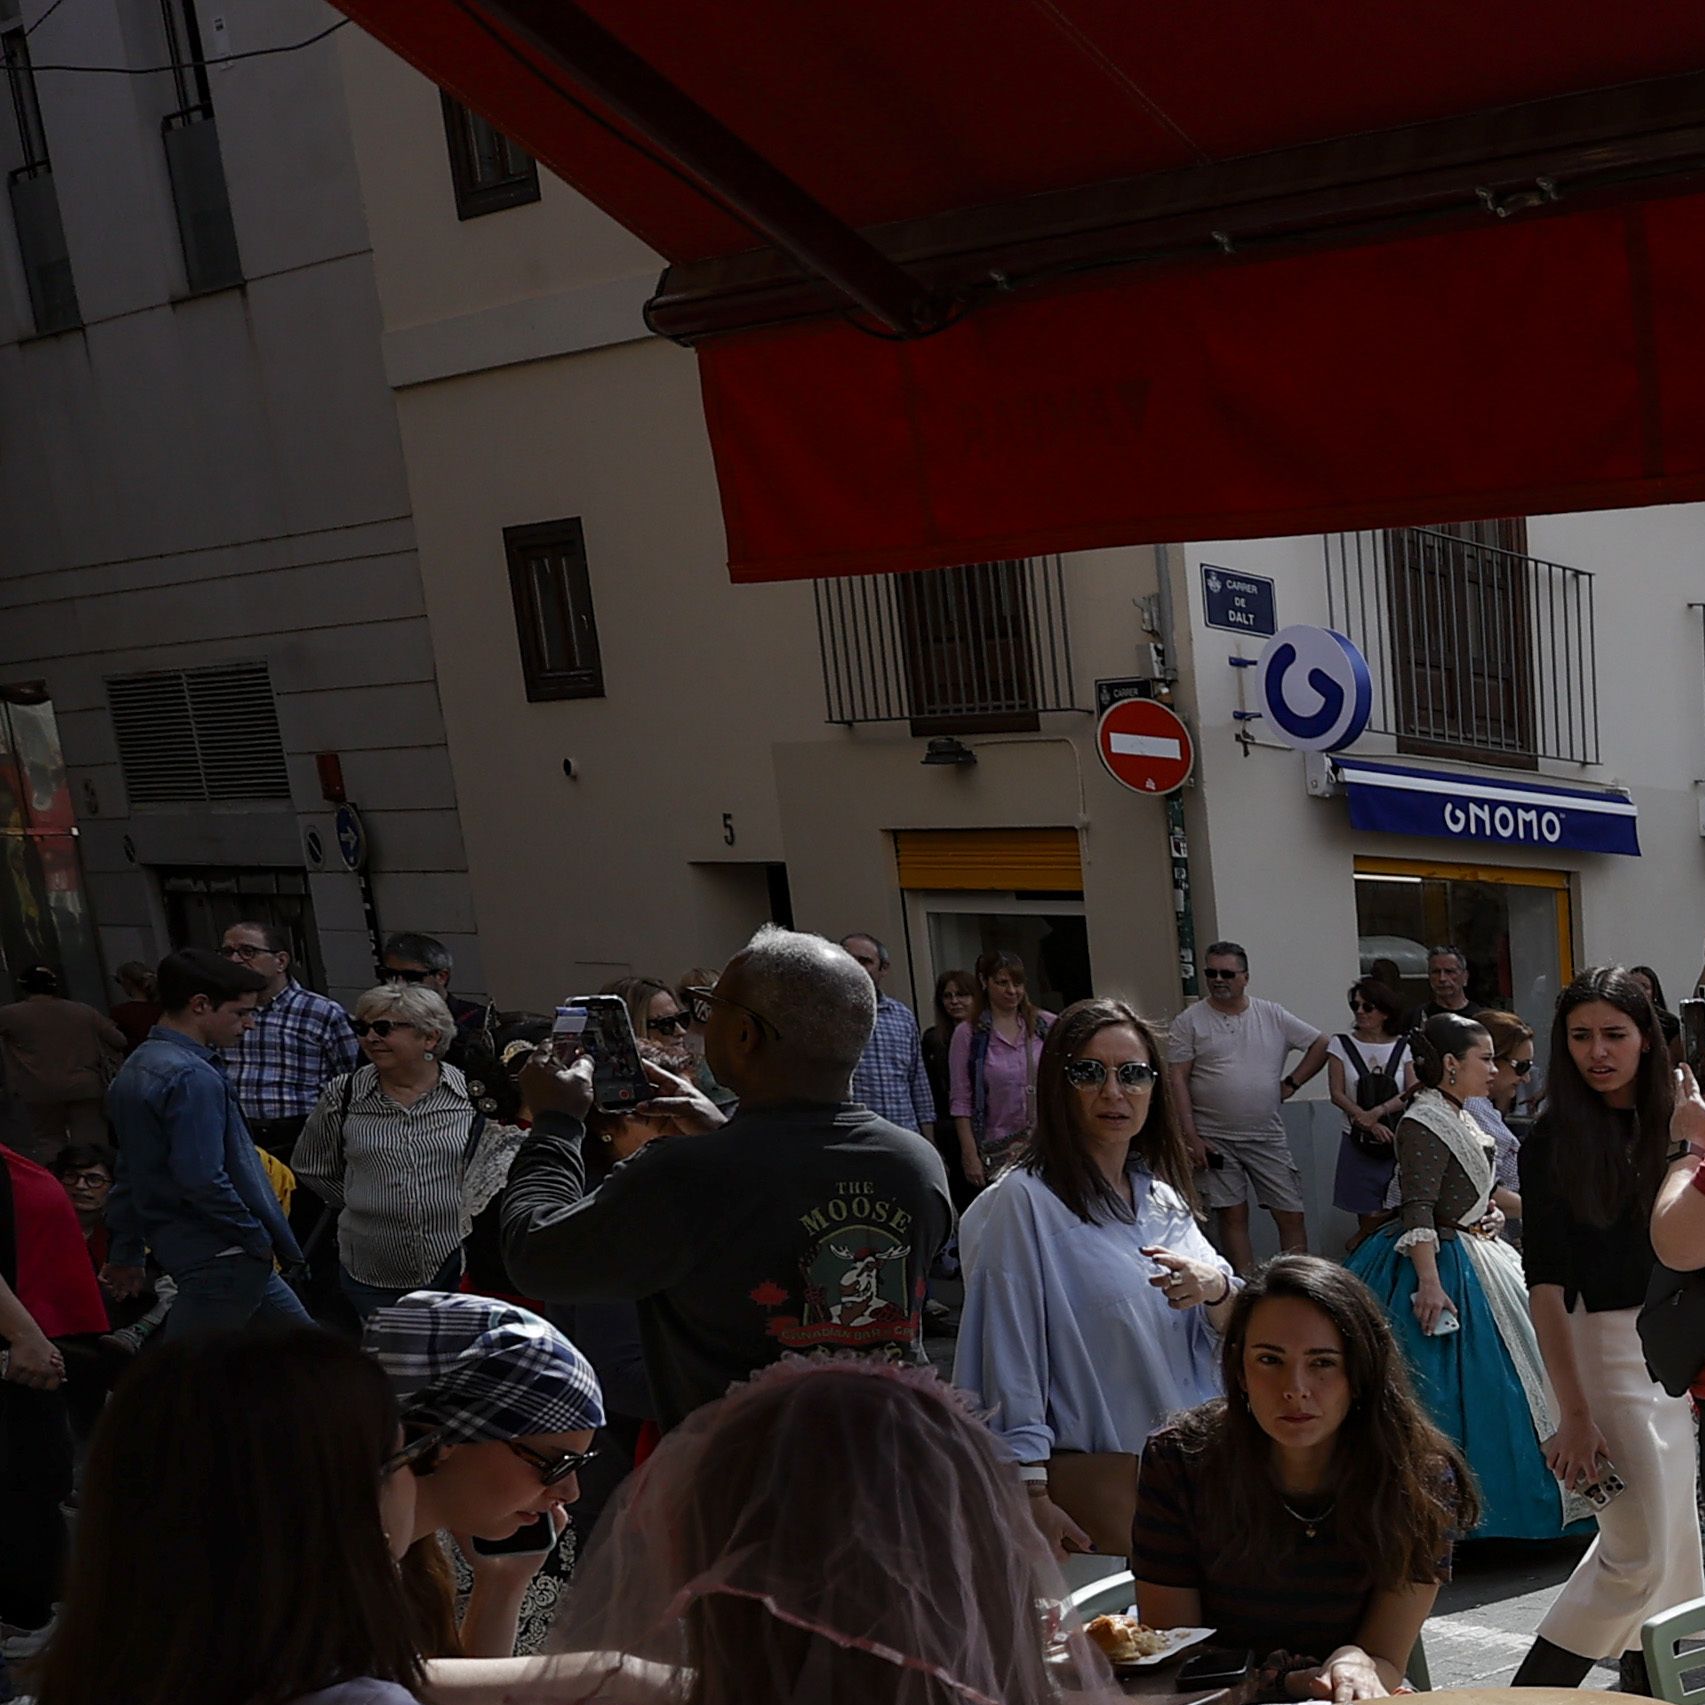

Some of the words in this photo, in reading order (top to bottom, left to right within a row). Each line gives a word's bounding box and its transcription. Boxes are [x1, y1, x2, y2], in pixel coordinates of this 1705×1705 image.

[1226, 580, 1258, 595] CARRER
[1234, 597, 1246, 608] DE
[1228, 610, 1255, 625] DALT
[723, 813, 736, 846] 5
[1444, 801, 1561, 843] GNOMO
[835, 1181, 874, 1196] THE
[799, 1196, 913, 1237] MOOSE
